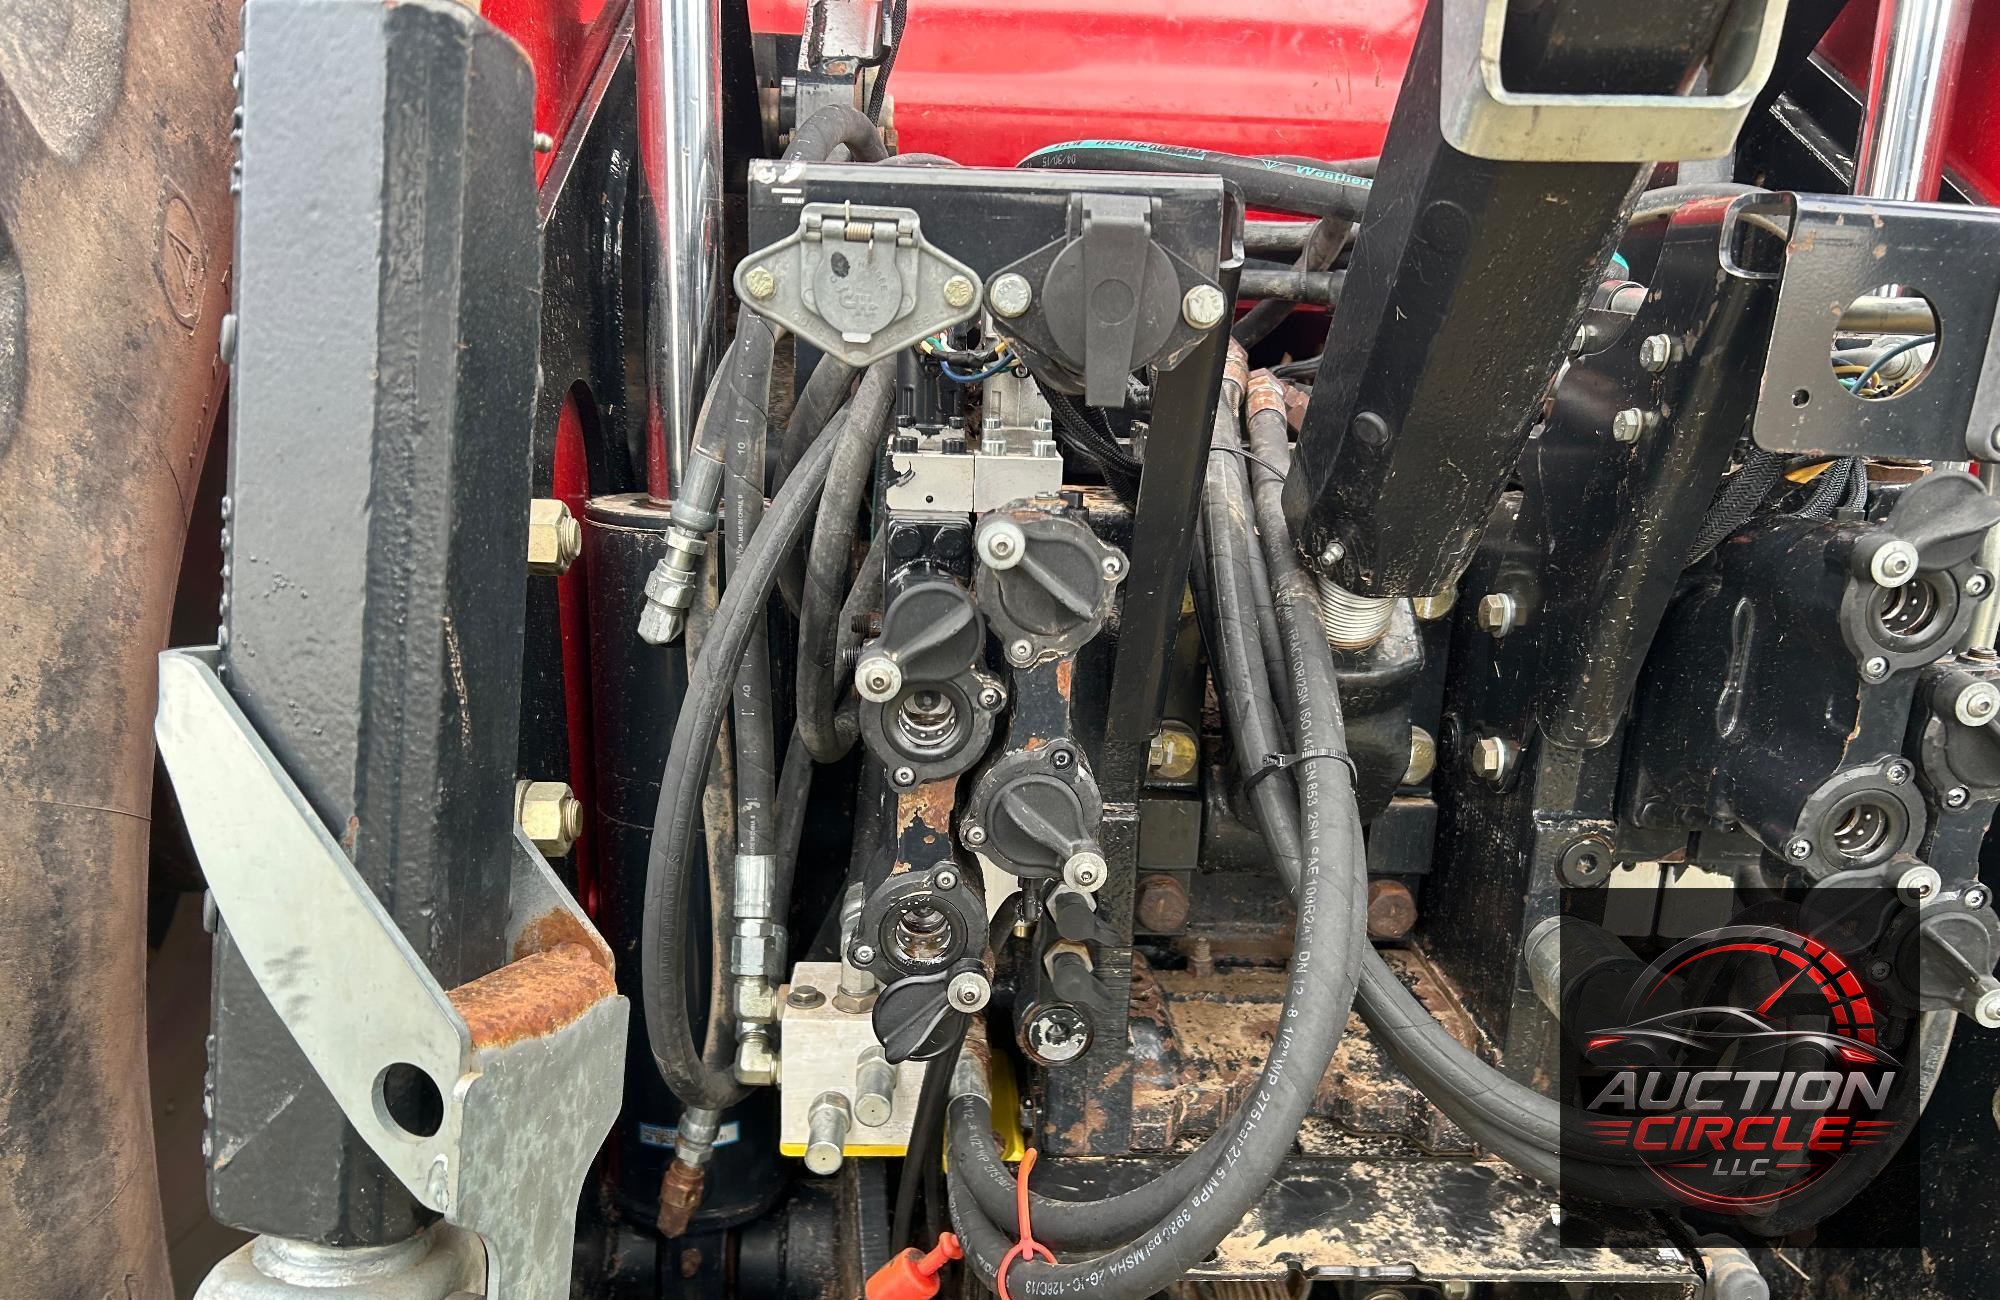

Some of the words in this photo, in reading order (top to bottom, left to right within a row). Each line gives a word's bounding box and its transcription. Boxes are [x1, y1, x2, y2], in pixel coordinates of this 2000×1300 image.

[1287, 625, 1309, 705] TRACTOR/2SN
[1299, 708, 1312, 730] ISO
[1304, 760, 1317, 782] EN
[1306, 783, 1318, 807] 853
[1307, 811, 1319, 840] 2SN
[1295, 951, 1311, 973] DN
[1291, 979, 1305, 995] 12
[1250, 1090, 1270, 1121] 275
[1237, 1121, 1256, 1146] bar
[1191, 1177, 1220, 1208] MPa
[1109, 1249, 1146, 1278] MSHA
